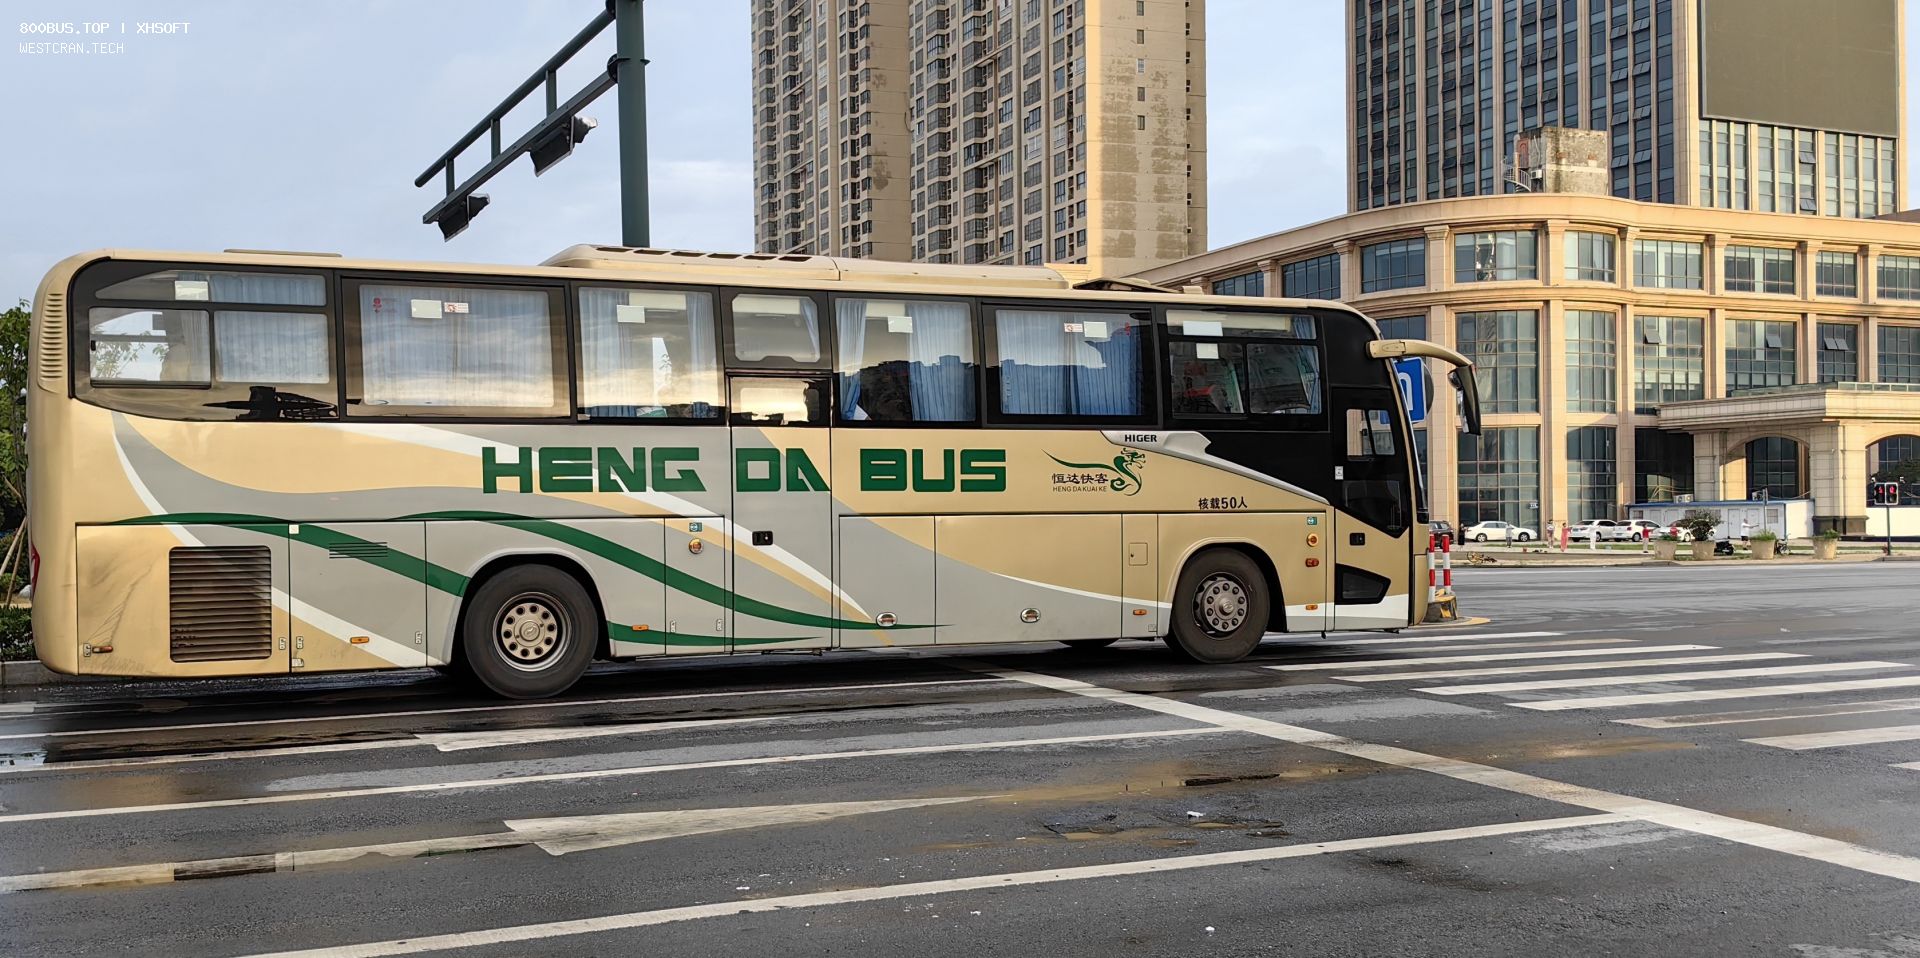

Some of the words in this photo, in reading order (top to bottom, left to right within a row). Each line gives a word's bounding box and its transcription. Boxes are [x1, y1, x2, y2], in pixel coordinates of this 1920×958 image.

[1124, 434, 1158, 443] HIGER
[482, 446, 707, 494] HENG
[735, 447, 831, 492] DA
[859, 448, 1007, 493] BUS
[1051, 472, 1109, 485] 恒达快客
[1198, 496, 1248, 510] 核载50人
